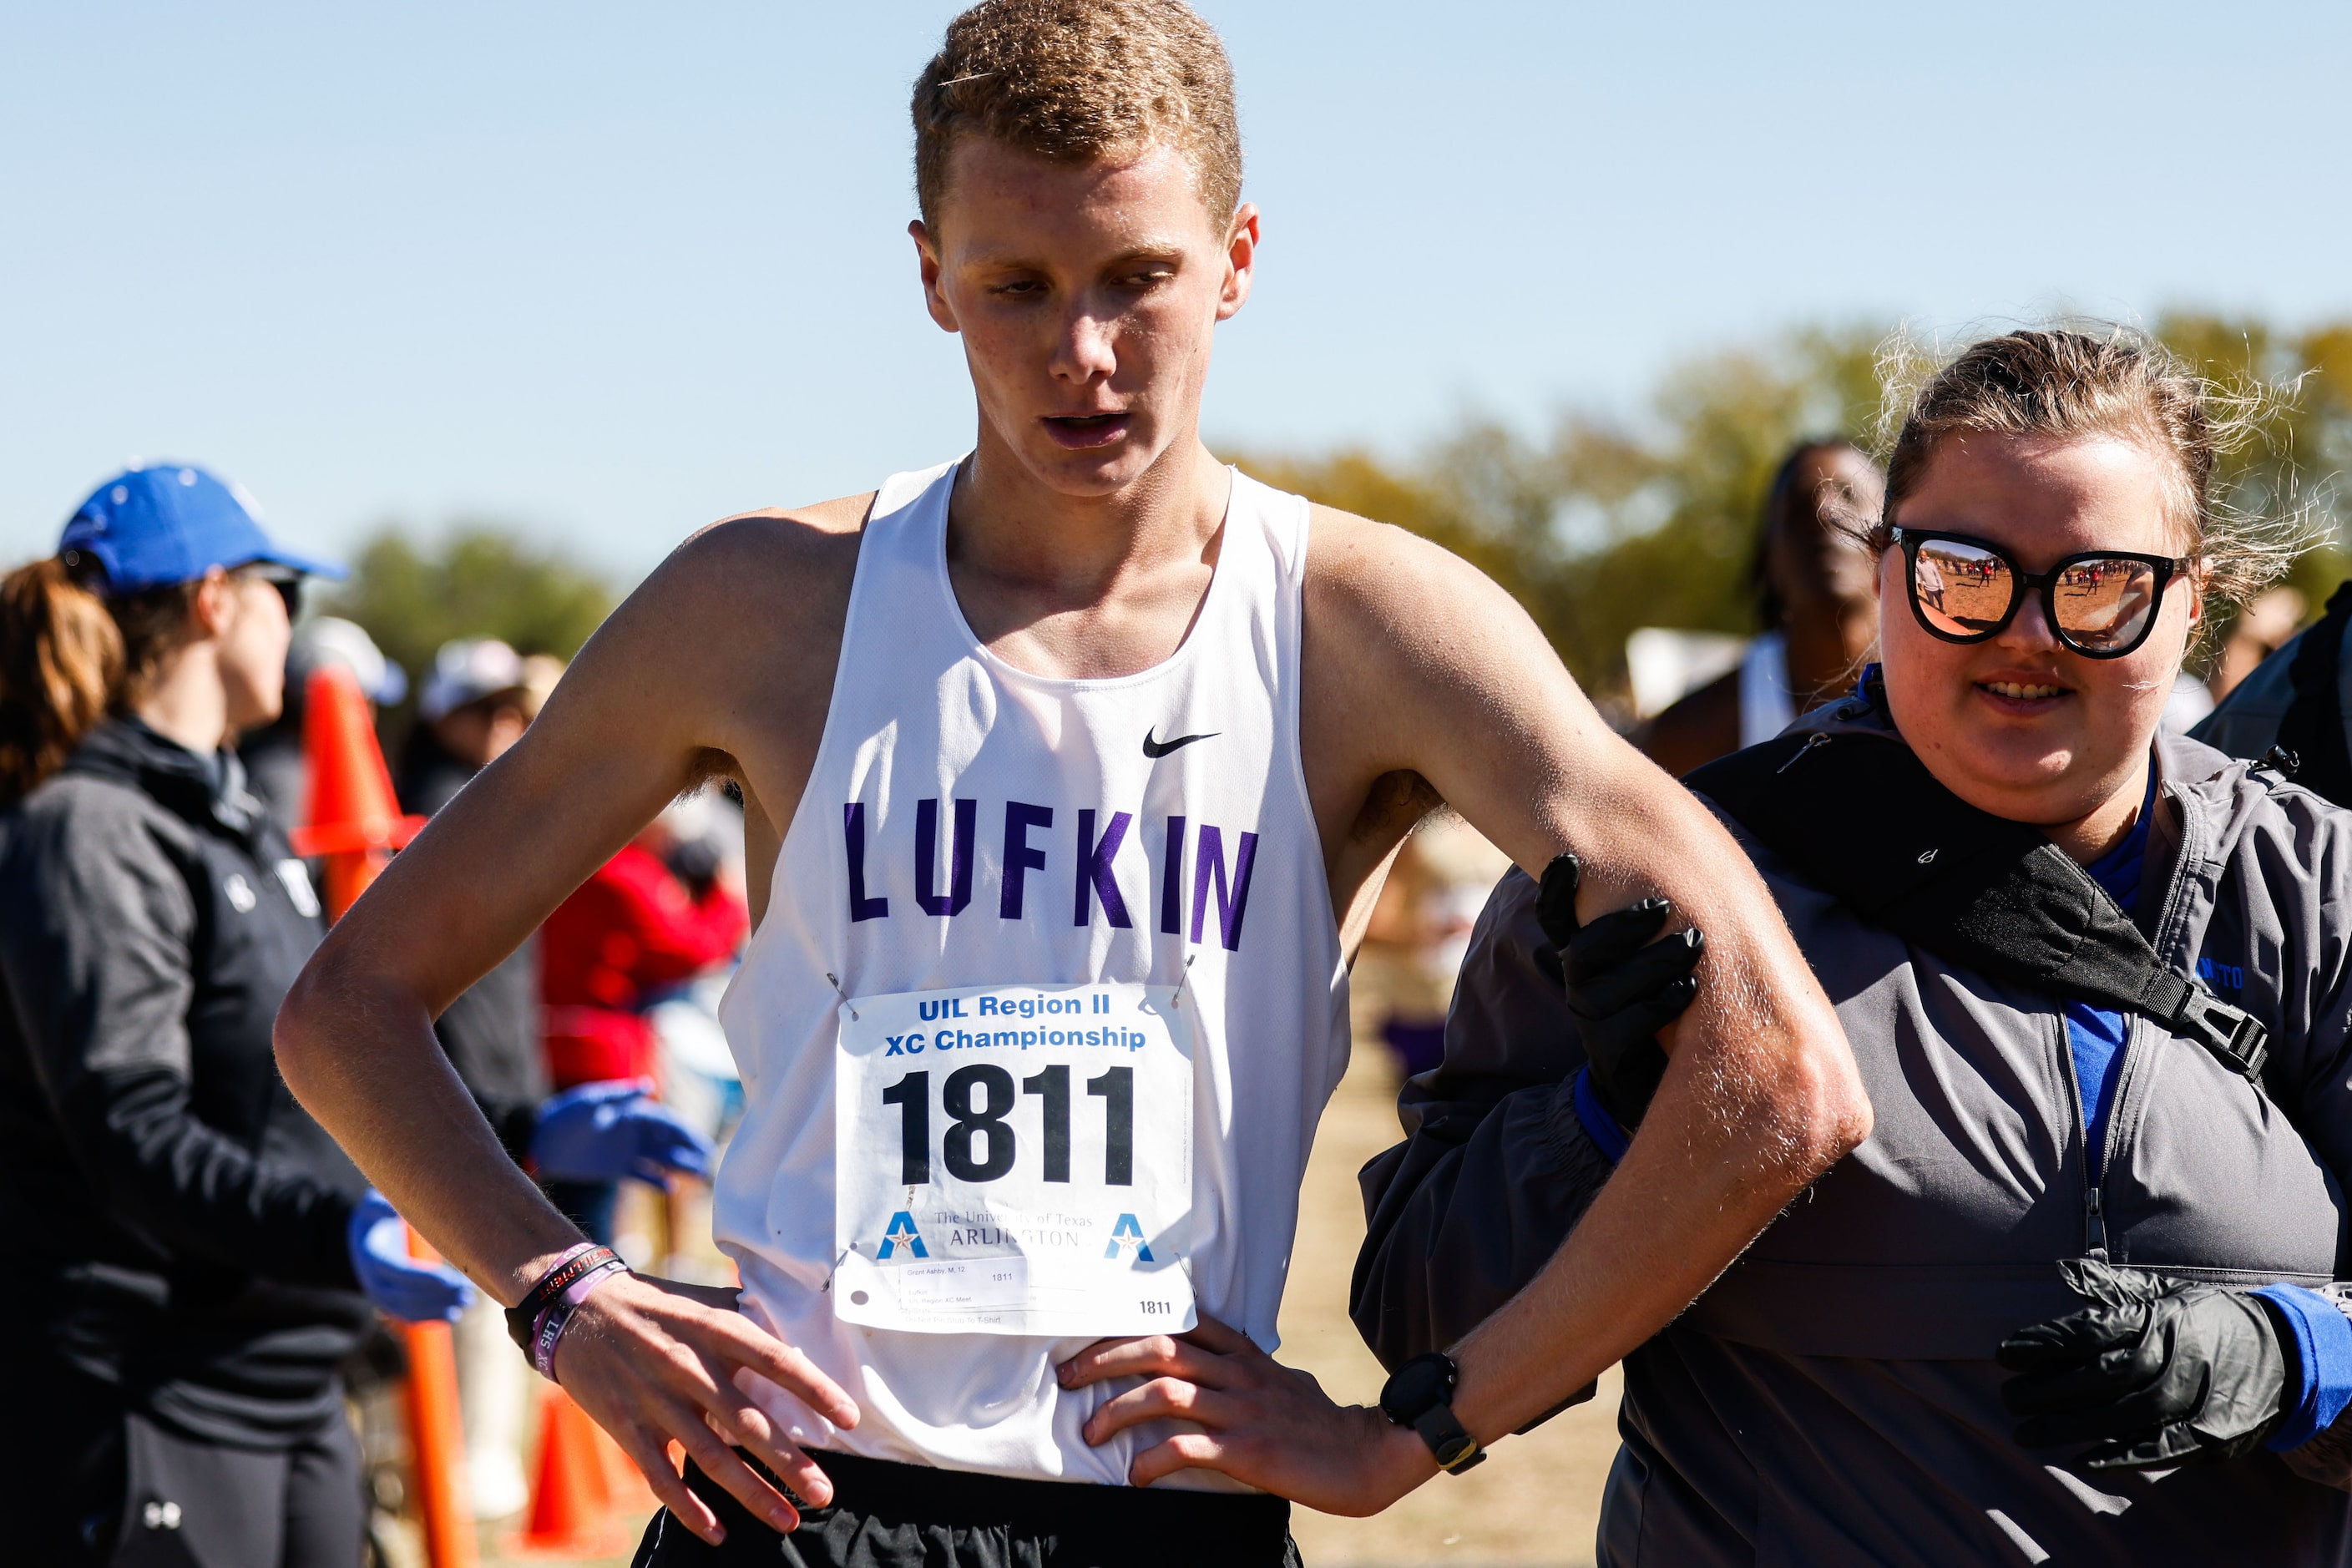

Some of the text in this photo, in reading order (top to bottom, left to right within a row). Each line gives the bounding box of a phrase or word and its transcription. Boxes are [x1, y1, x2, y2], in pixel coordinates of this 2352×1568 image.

[843, 798, 1259, 952] LUFKIN
[919, 994, 1110, 1021] UIL Region II
[885, 1025, 1147, 1057] XC Championship
[883, 1064, 1134, 1186] 1811
[934, 1211, 1093, 1227] The Univerity of Texas
[992, 1273, 1013, 1282] 1811
[1140, 1301, 1171, 1314] 1811
[540, 1319, 559, 1349] LHS
